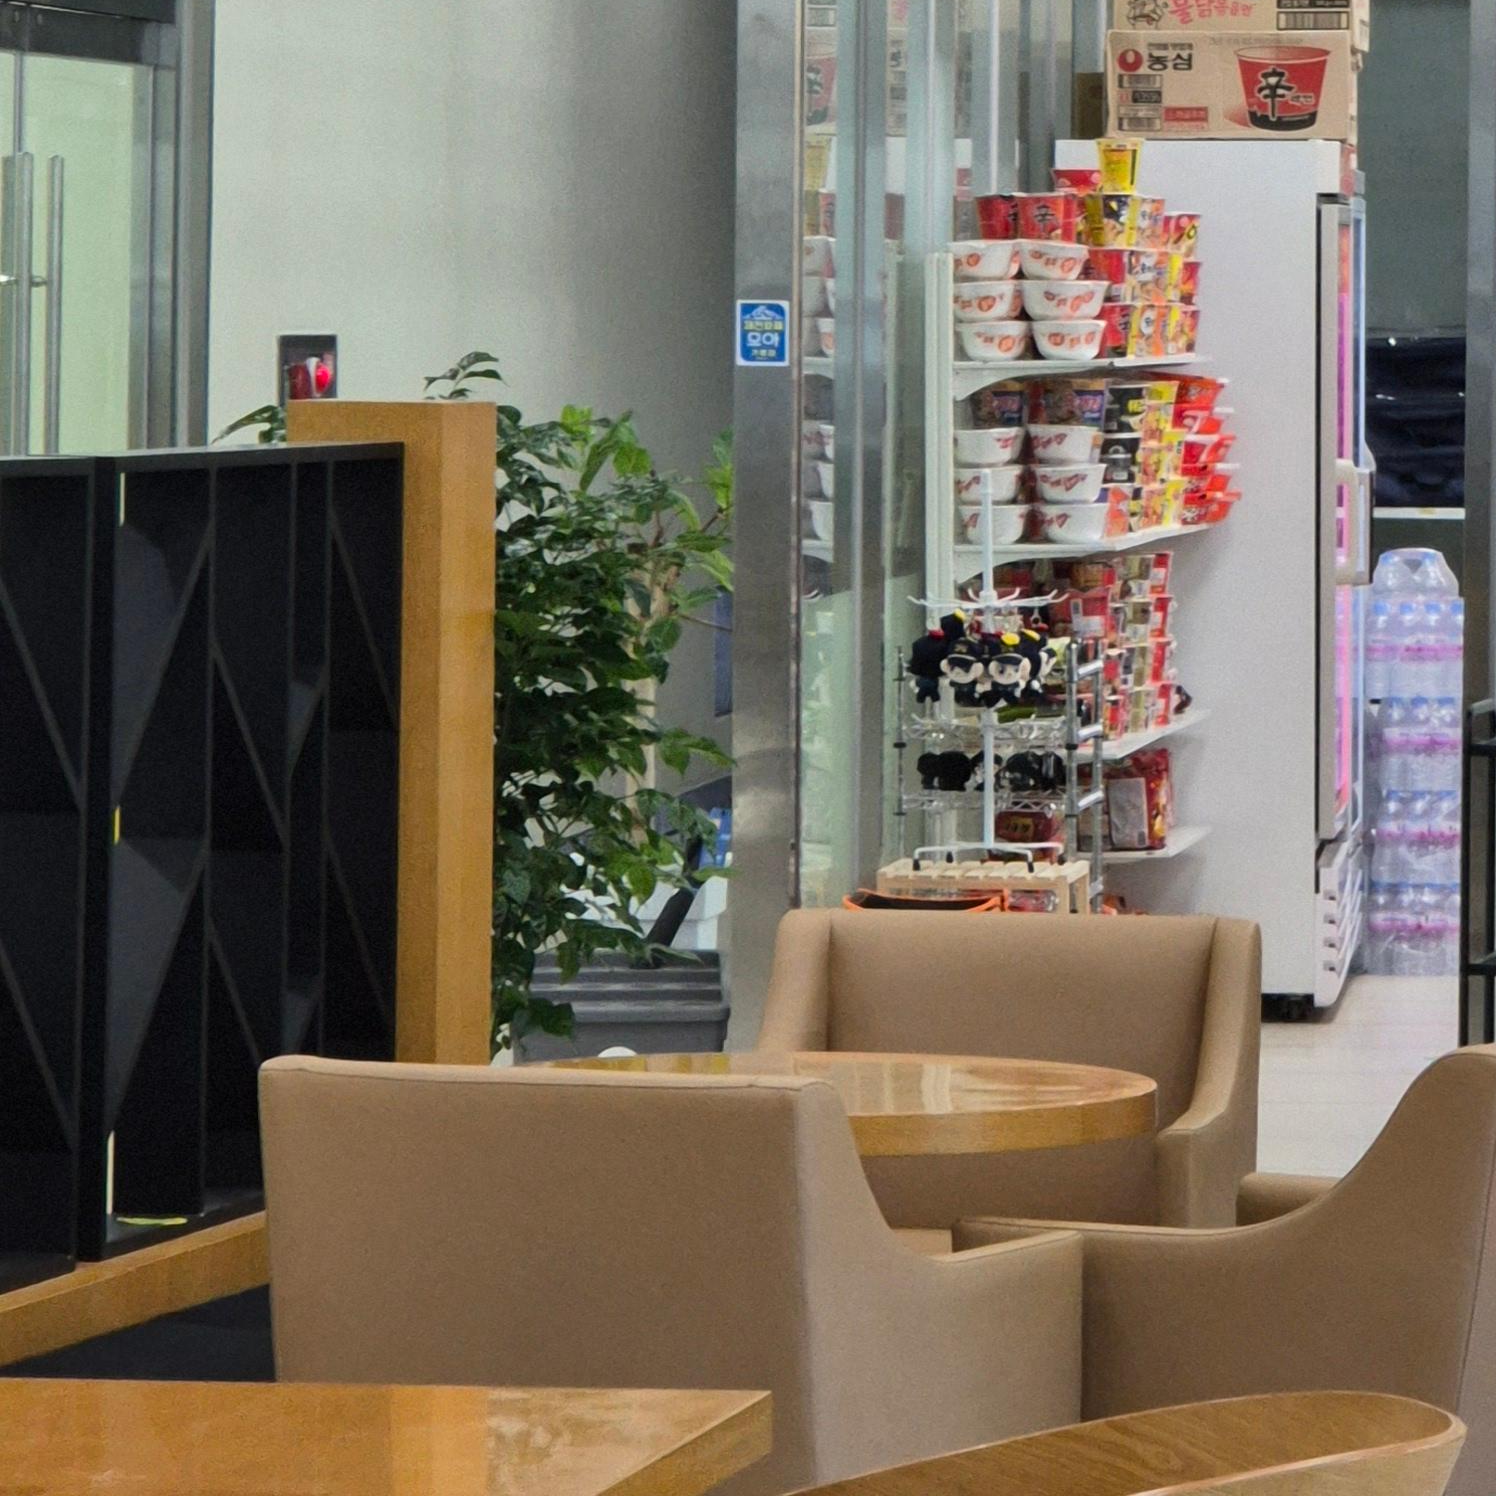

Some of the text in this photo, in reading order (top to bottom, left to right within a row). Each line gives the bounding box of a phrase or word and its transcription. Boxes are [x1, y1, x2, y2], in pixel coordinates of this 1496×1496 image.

[1147, 52, 1193, 72] 농심
[1257, 67, 1294, 122] 辛
[747, 332, 779, 348] 모아
